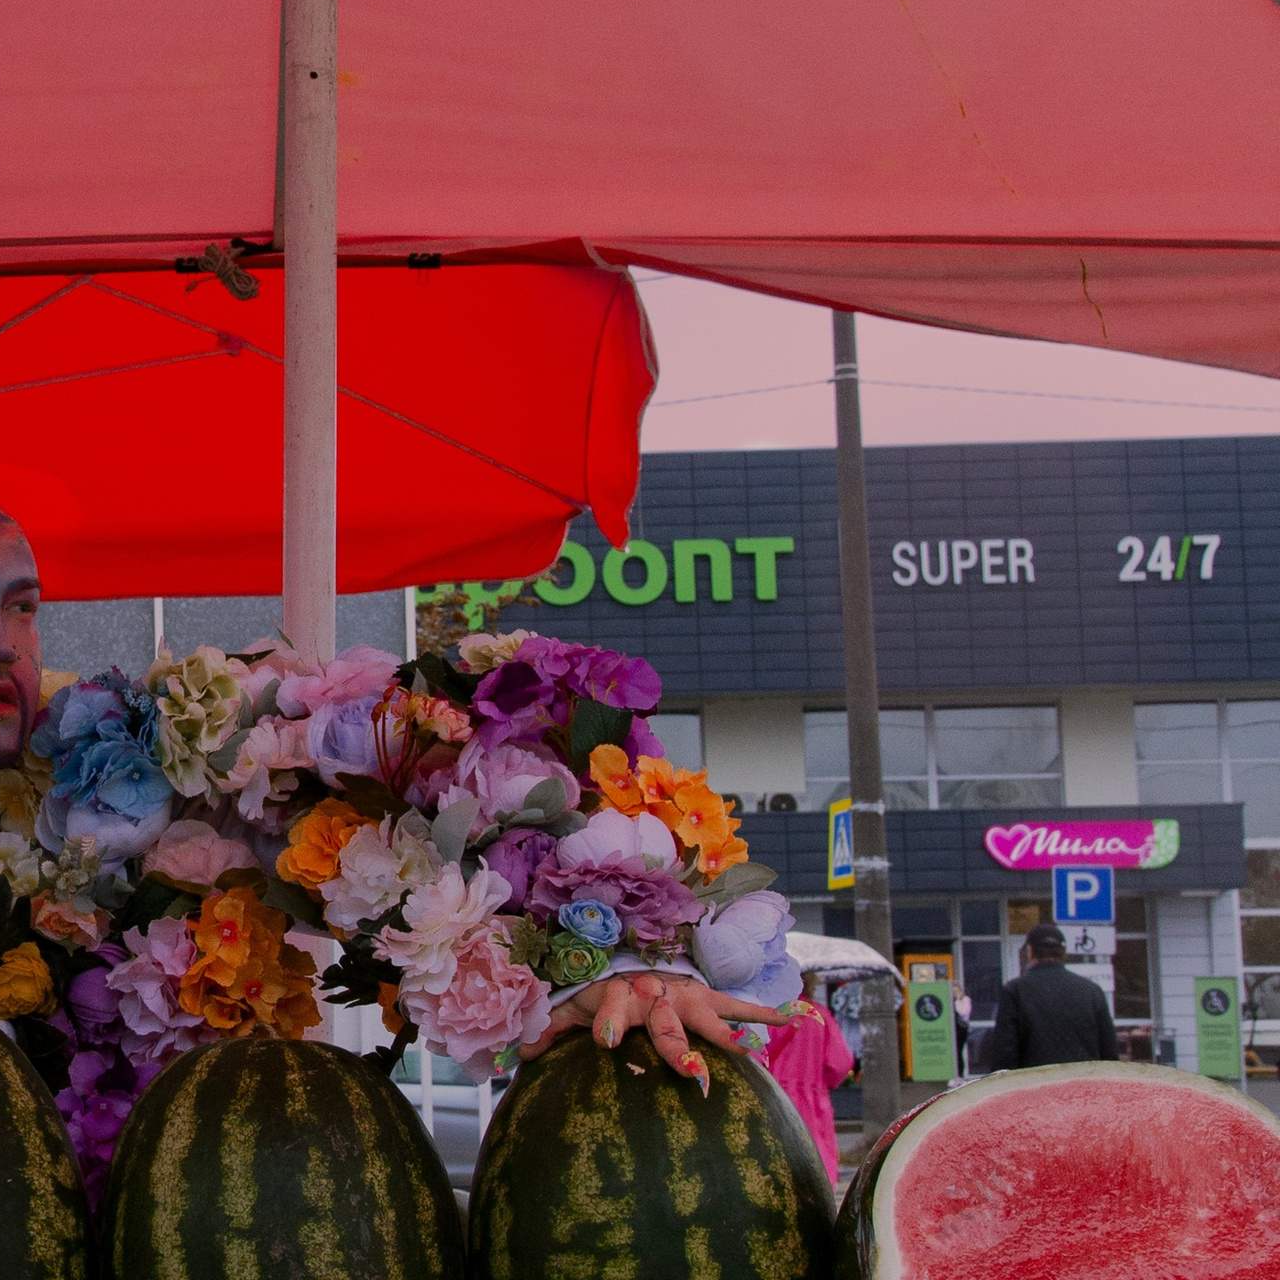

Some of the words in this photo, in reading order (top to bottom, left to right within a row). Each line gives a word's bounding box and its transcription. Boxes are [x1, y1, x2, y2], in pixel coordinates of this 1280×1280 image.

[891, 537, 1036, 586] SUPER
[1116, 534, 1222, 582] 24/7
[1066, 871, 1101, 917] P
